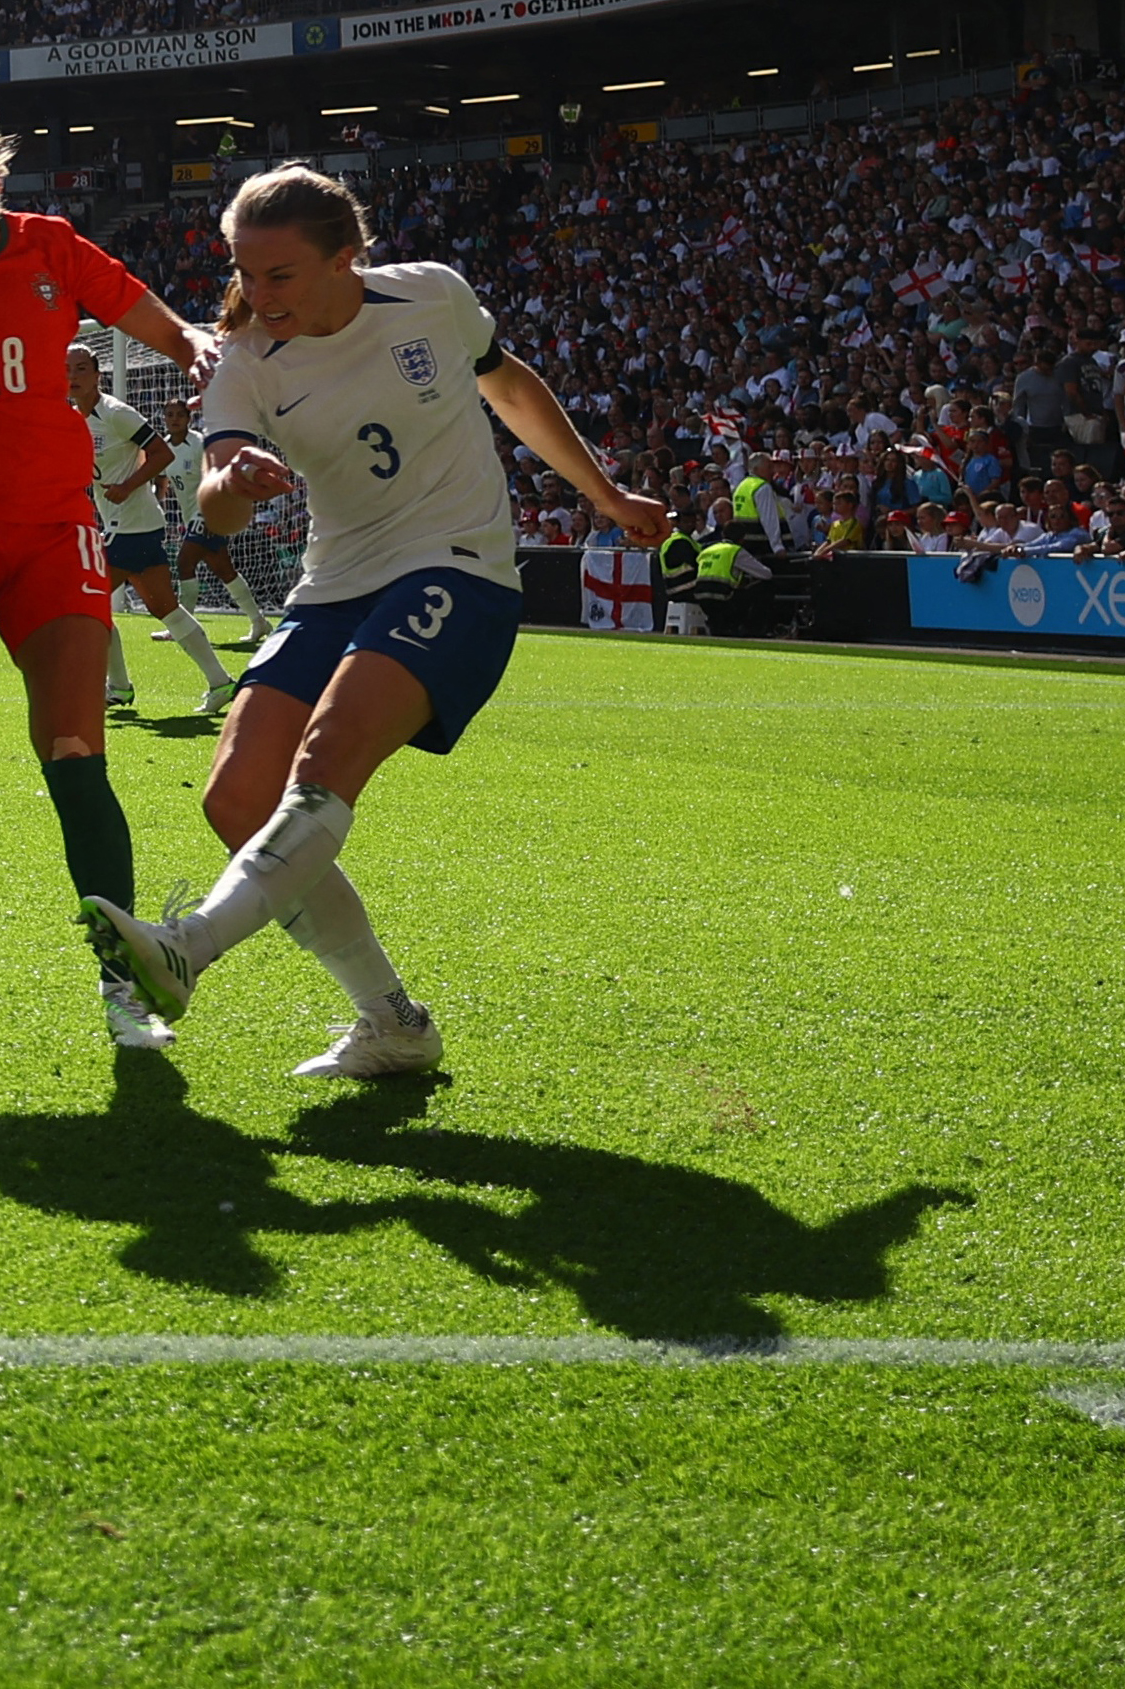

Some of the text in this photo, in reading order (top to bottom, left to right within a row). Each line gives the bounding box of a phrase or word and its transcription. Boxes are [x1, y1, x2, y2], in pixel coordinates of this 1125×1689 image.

[353, 21, 390, 40] JOIN
[394, 16, 424, 34] THE
[428, 8, 486, 30] MKDSA
[47, 28, 257, 62] A GOODMAN & SON
[65, 48, 240, 76] METAL RECYCLING
[1096, 63, 1118, 79] 24
[525, 140, 539, 153] 29
[72, 175, 88, 188] 28
[177, 168, 193, 181] 28
[357, 422, 401, 480] 3
[190, 517, 205, 534] 16
[76, 524, 106, 579] 18
[1012, 588, 1042, 603] xero
[407, 585, 453, 640] 3
